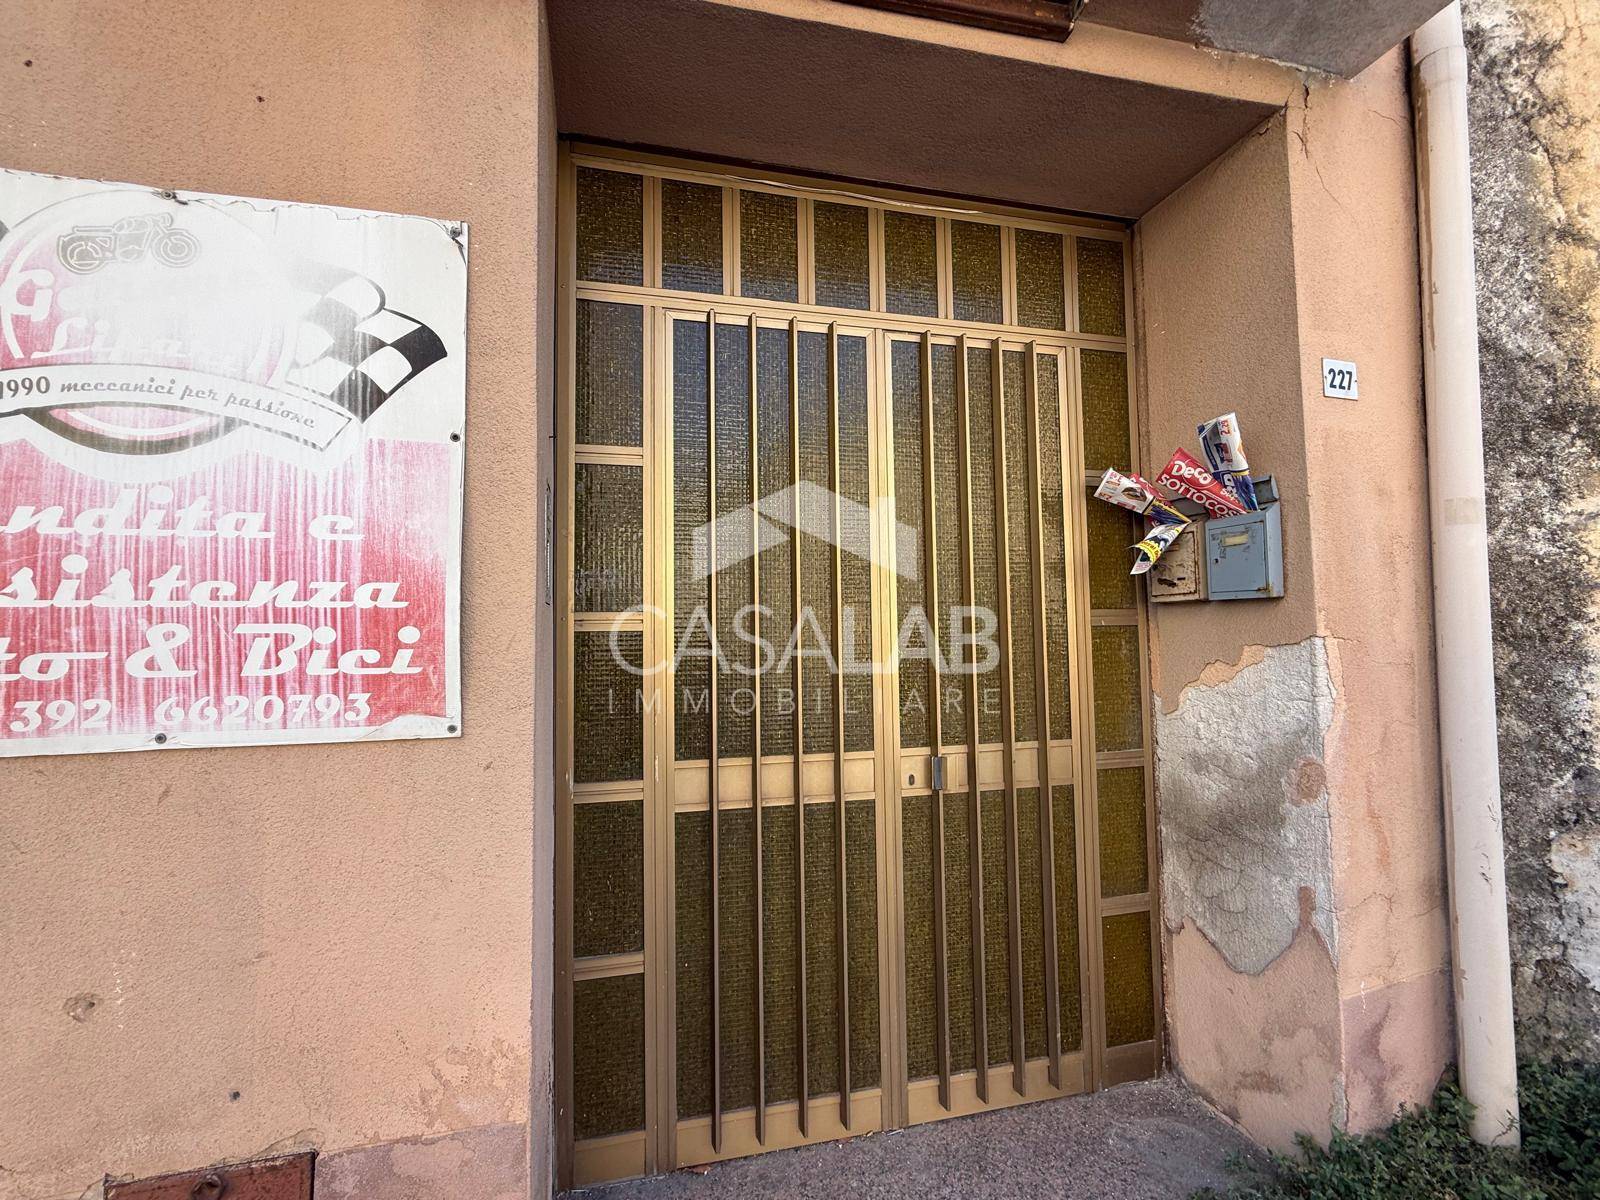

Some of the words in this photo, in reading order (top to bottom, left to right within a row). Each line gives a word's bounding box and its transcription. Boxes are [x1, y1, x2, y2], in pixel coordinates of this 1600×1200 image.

[1327, 367, 1354, 391] 227
[60, 376, 176, 395] meccanici
[180, 385, 218, 401] per
[224, 392, 316, 428] passione
[308, 513, 365, 541] e
[124, 623, 198, 679] &
[232, 623, 424, 679] Bici
[10, 699, 112, 732] 392
[153, 692, 372, 725] 6620793
